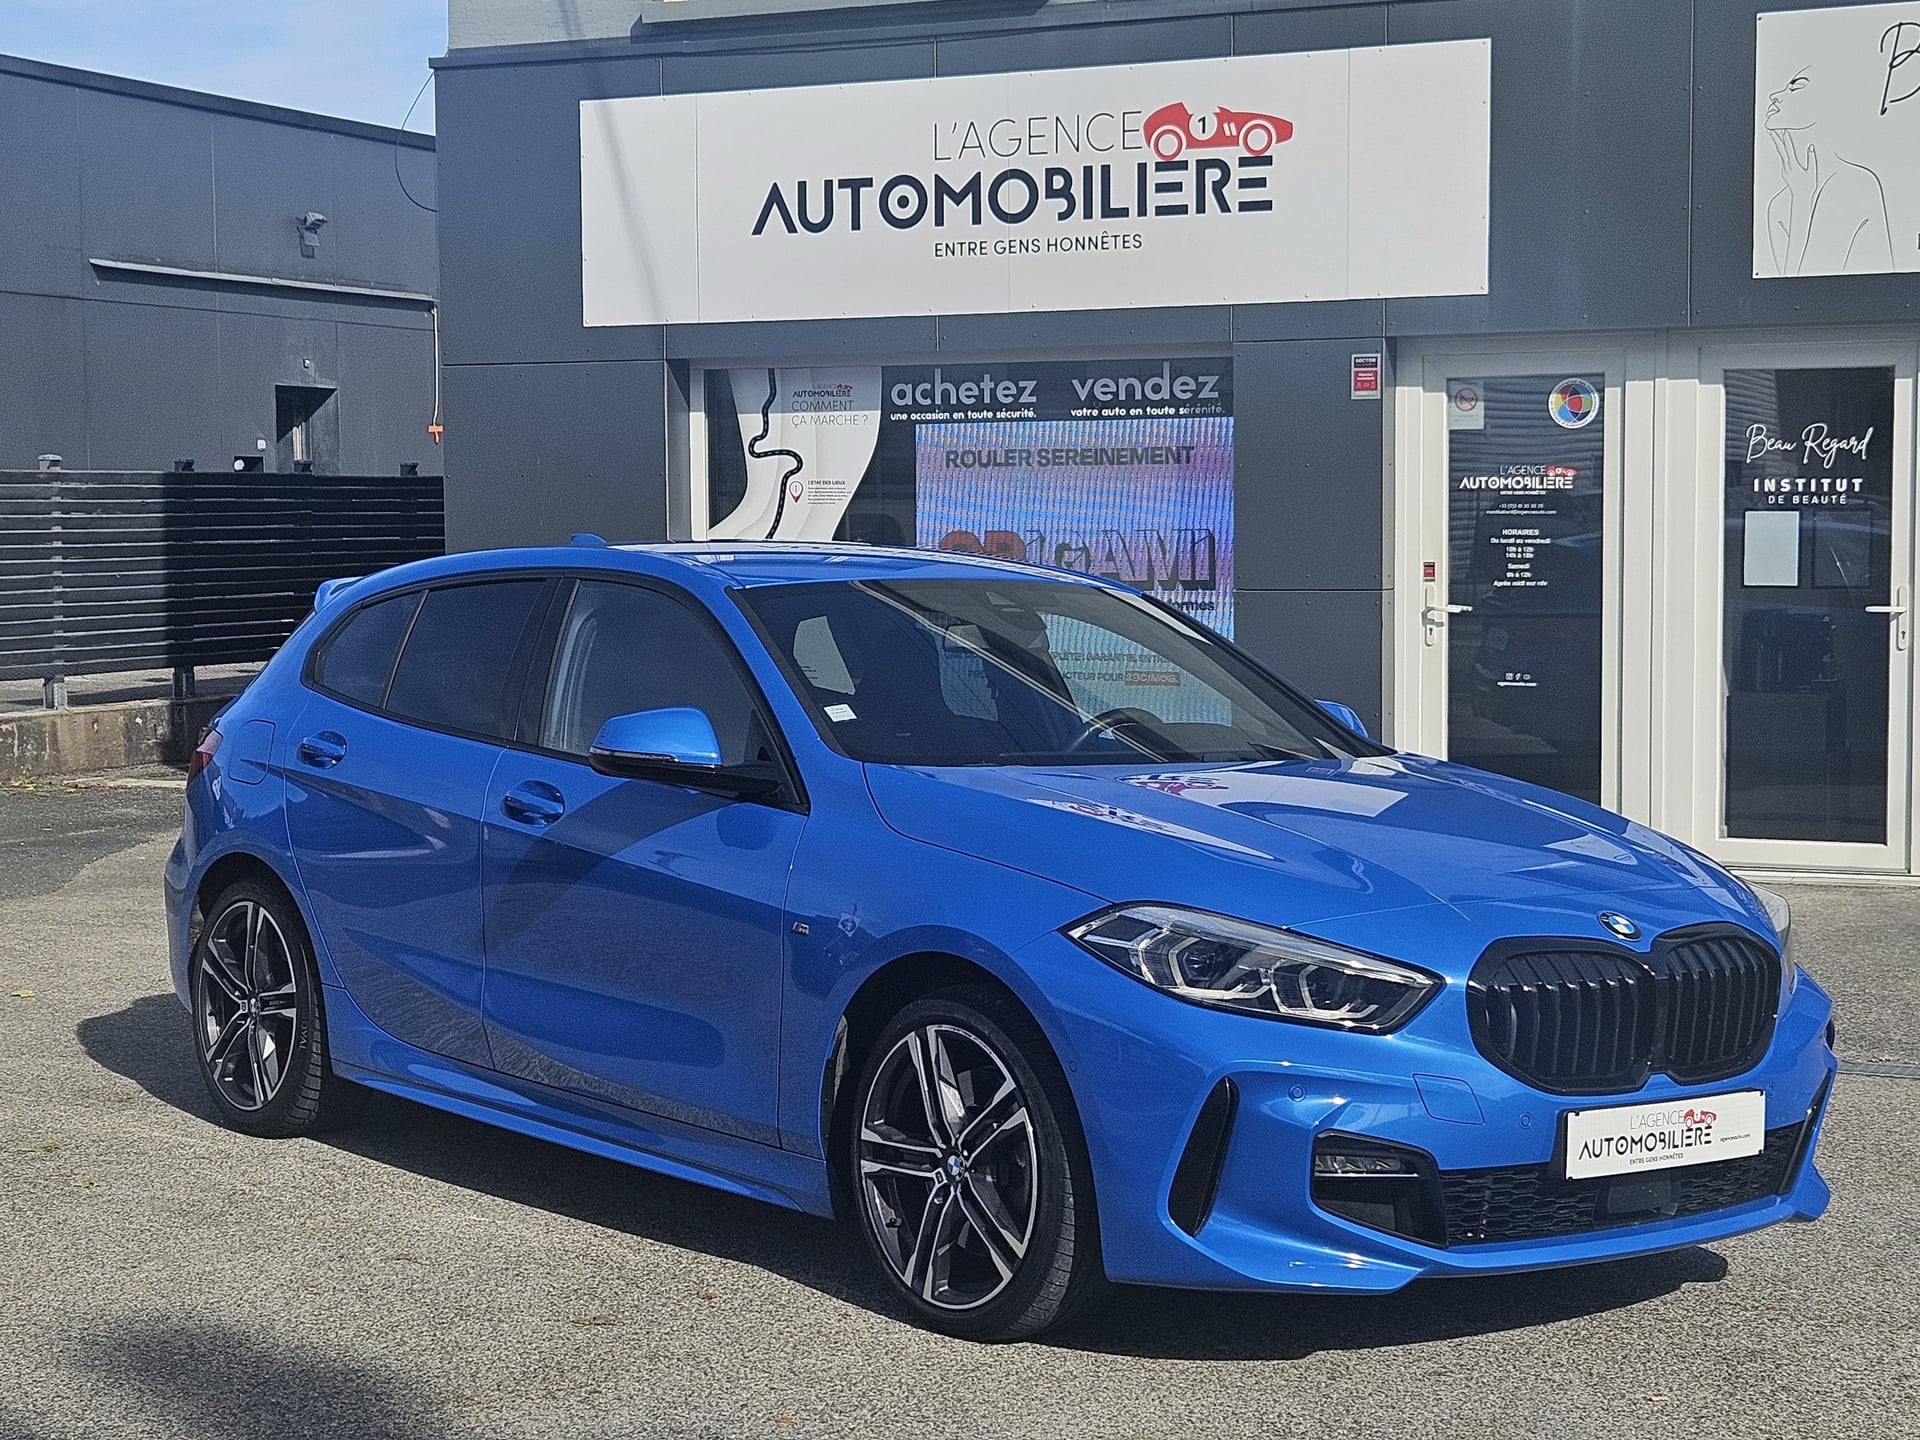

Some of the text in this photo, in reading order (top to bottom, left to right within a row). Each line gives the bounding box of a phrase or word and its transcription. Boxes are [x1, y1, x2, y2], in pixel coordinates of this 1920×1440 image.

[934, 111, 1142, 160] L'AGENCE
[751, 155, 1273, 236] AUTOMOBILIERE
[935, 231, 1142, 257] ENTRE GENS HONNÊTES
[891, 368, 1038, 406] achetez
[1071, 361, 1219, 401] vendez
[792, 400, 854, 412] COMMENT
[891, 407, 1037, 421] une occasion en toute sécurité.
[1070, 403, 1225, 417] votre auto en toute sérénité.
[792, 414, 869, 428] ÇA MARCHE ?
[1746, 423, 1874, 469] Beau Regard
[945, 446, 1194, 469] ROULER SEREINEMENT
[1500, 465, 1546, 475] L'AGENCE
[1753, 478, 1863, 492] INSTITUT
[1768, 493, 1847, 505] DE BEAUTÉ
[1630, 1110, 1684, 1129] L'AGENCE
[1578, 1126, 1712, 1160] AUTOMOBILIERE
